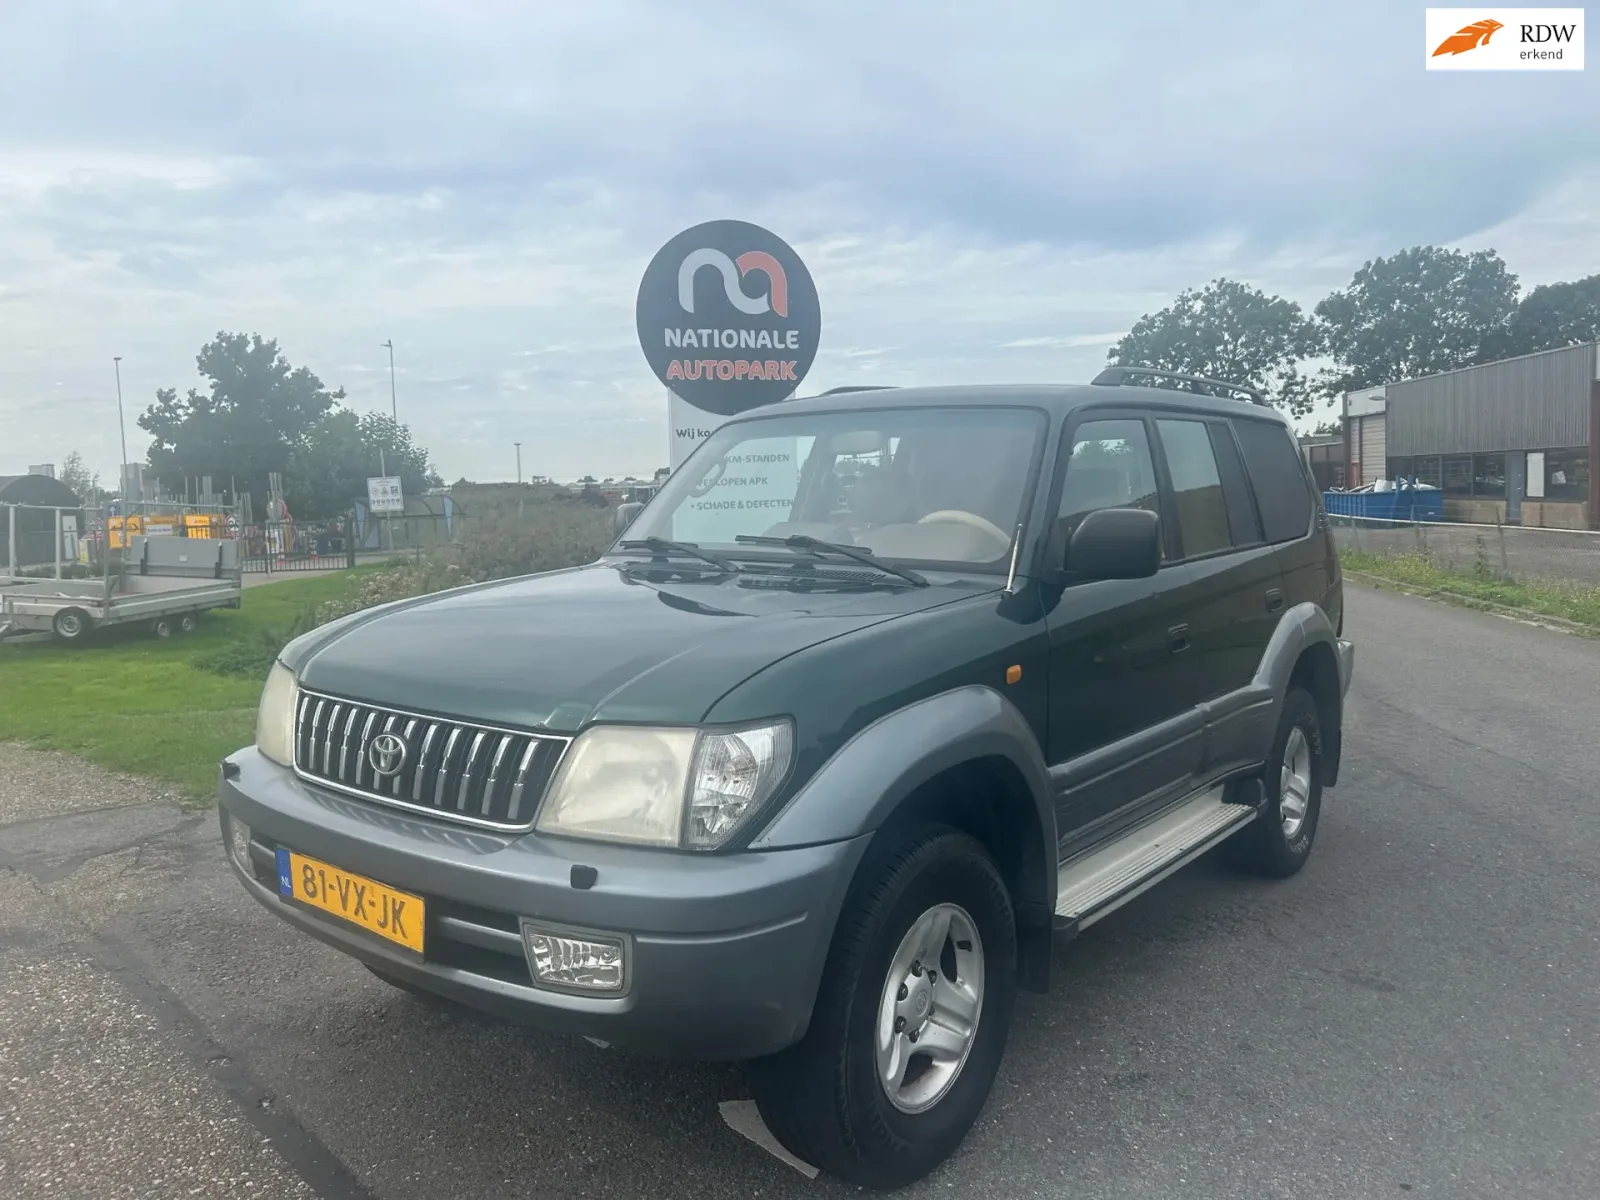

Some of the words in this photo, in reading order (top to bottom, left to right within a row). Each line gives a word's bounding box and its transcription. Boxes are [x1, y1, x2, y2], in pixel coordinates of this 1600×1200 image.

[664, 328, 799, 349] NATIONALE
[666, 359, 798, 380] AUTOPARK
[676, 428, 695, 440] Wij
[725, 454, 790, 463] KM-STANDEN
[748, 476, 768, 485] APK
[696, 501, 736, 510] SCHADE
[737, 500, 745, 509] &
[746, 498, 794, 509] DEFECTEN
[281, 875, 291, 888] NL
[302, 864, 408, 939] 81-VX-JK
